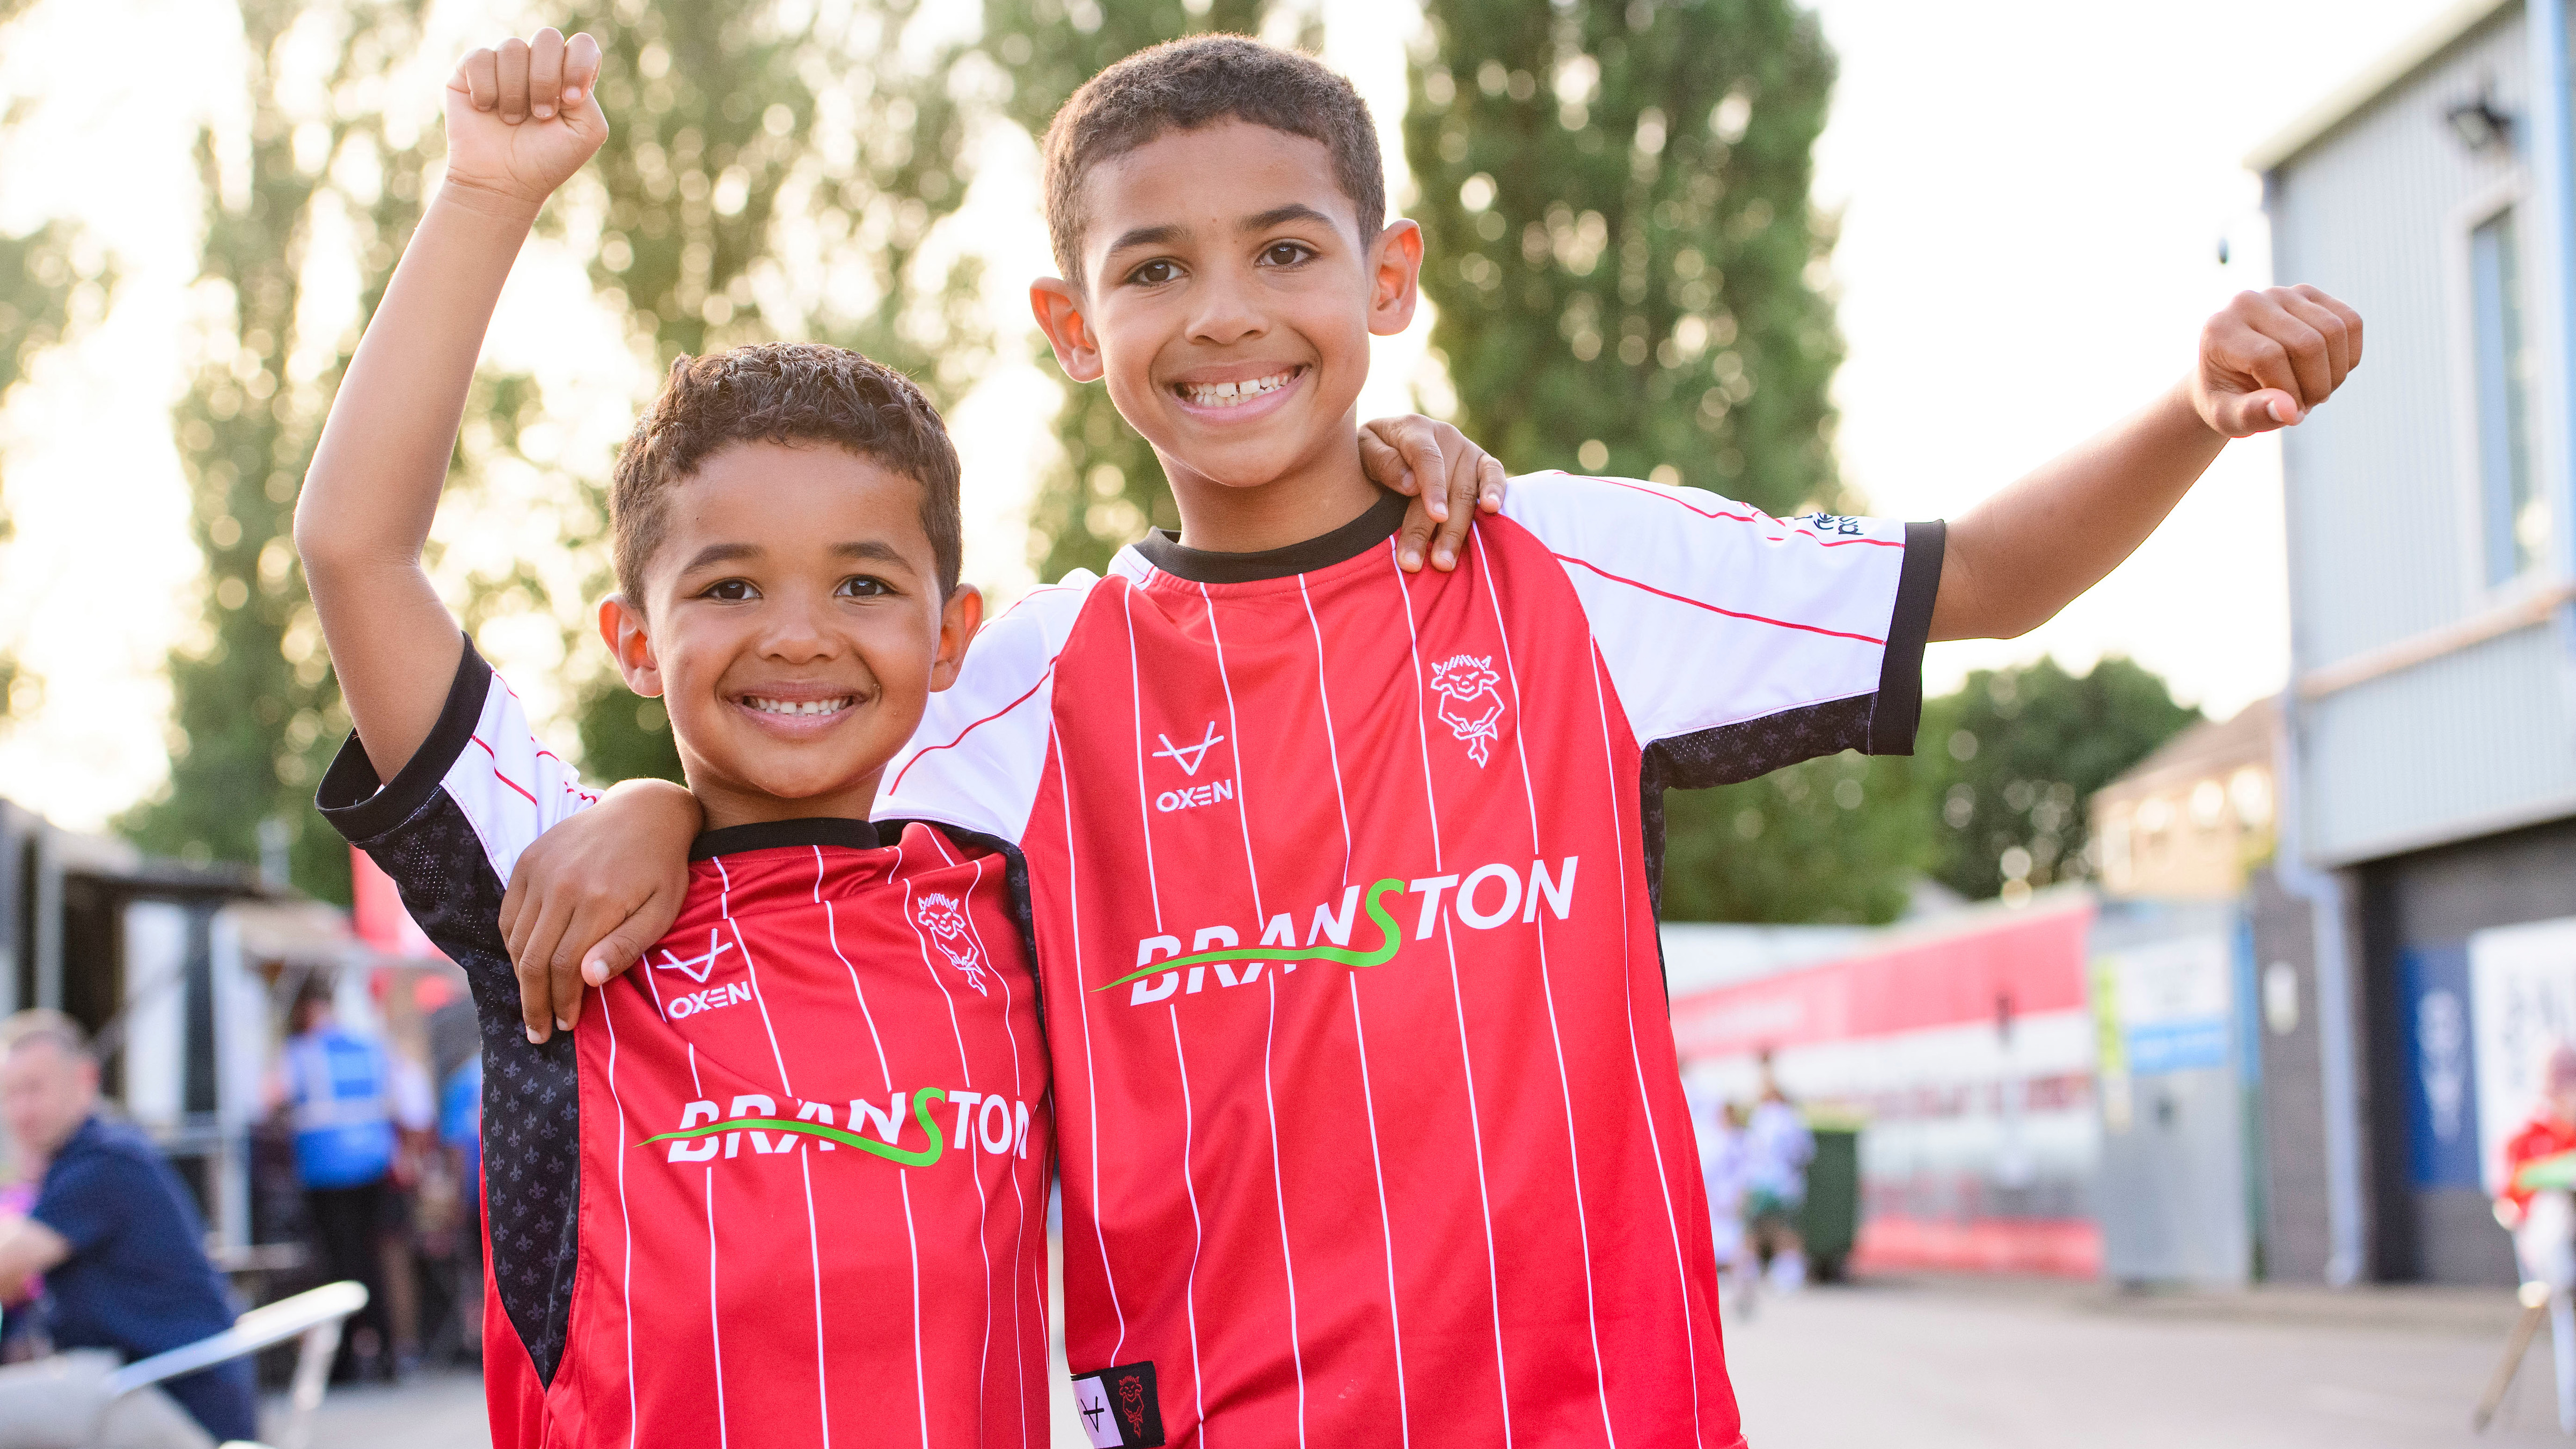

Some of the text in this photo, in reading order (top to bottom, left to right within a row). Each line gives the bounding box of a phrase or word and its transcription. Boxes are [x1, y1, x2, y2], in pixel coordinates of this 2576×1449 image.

[1156, 779, 1233, 813] OXEN
[1089, 856, 1578, 1006] BRANSTON
[668, 981, 751, 1019] OXEN
